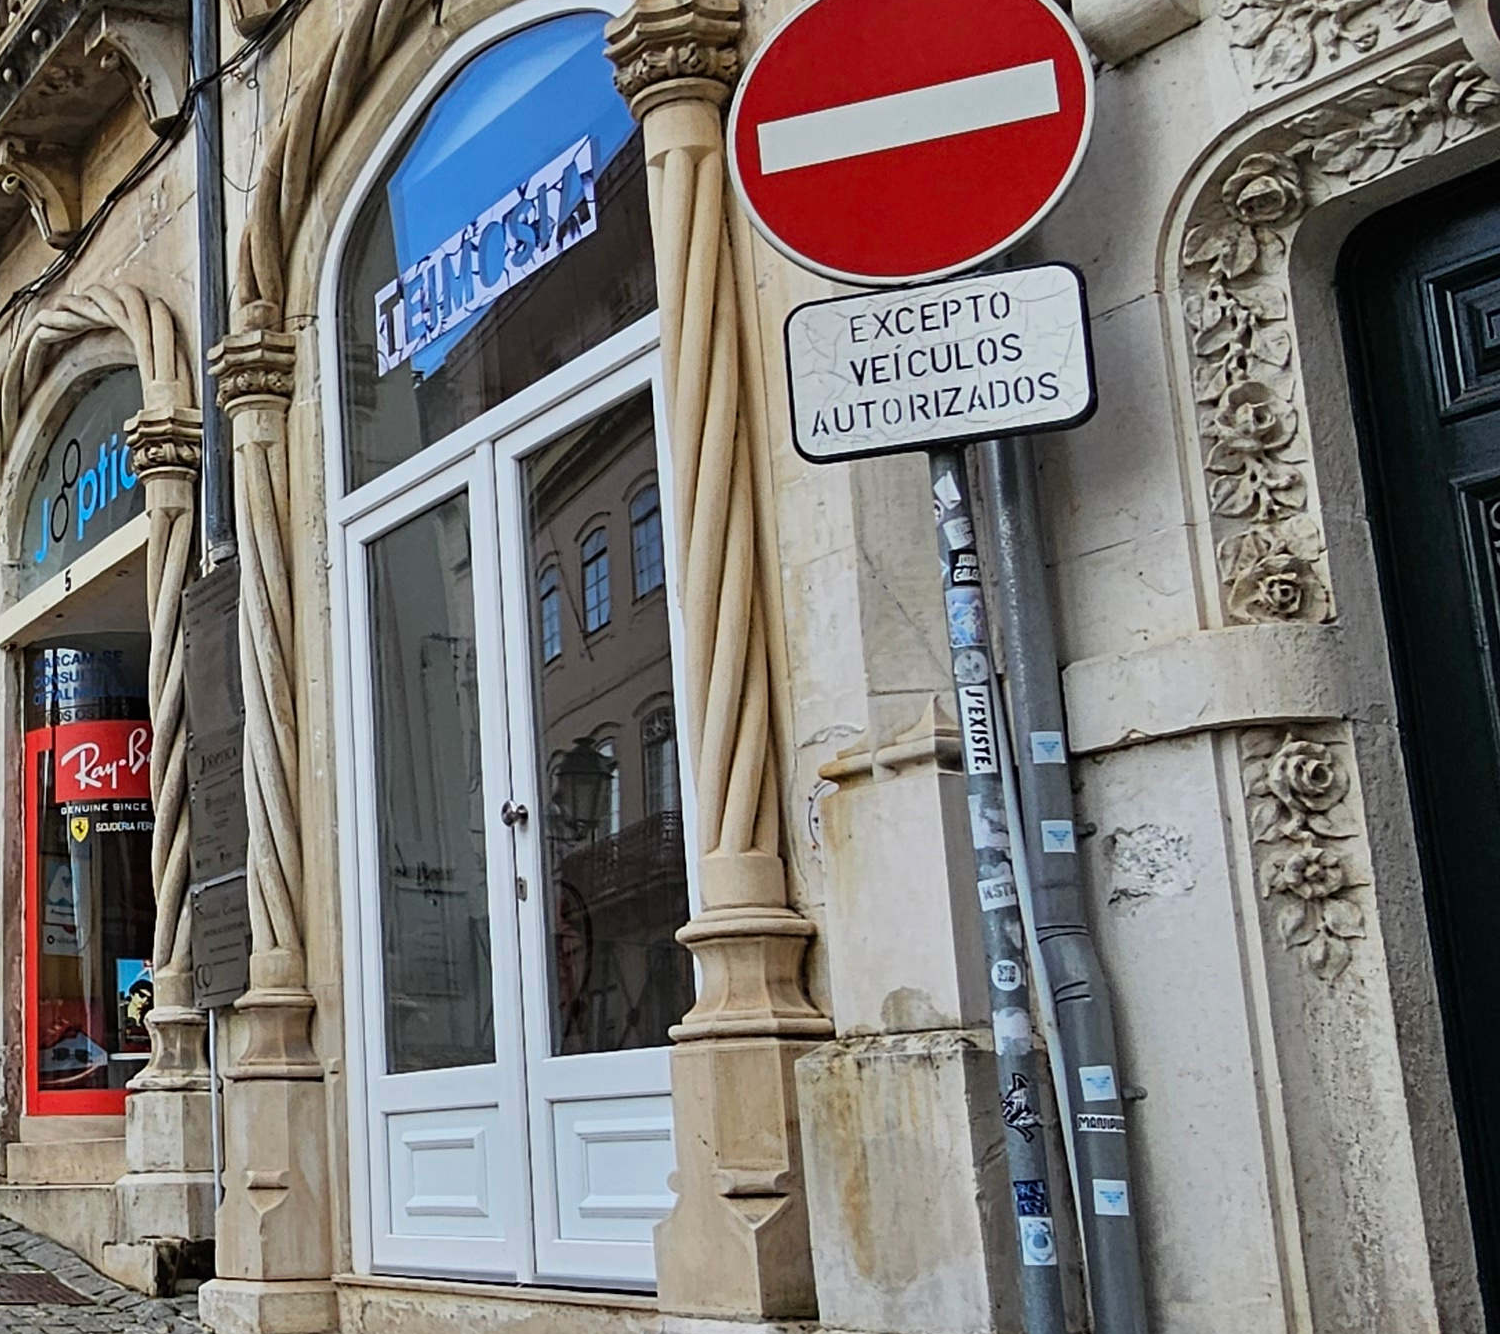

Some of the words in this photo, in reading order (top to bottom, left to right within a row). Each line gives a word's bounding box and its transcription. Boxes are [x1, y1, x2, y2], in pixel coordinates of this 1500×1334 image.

[850, 291, 1011, 343] EXCEPTO
[850, 333, 1023, 387] VEÍCULOS
[811, 372, 1060, 437] AUTORIZADOS
[64, 569, 72, 592] 5
[965, 690, 992, 771] J'EXISTE.
[61, 728, 152, 790] Ray-B
[112, 803, 148, 812] SINCE
